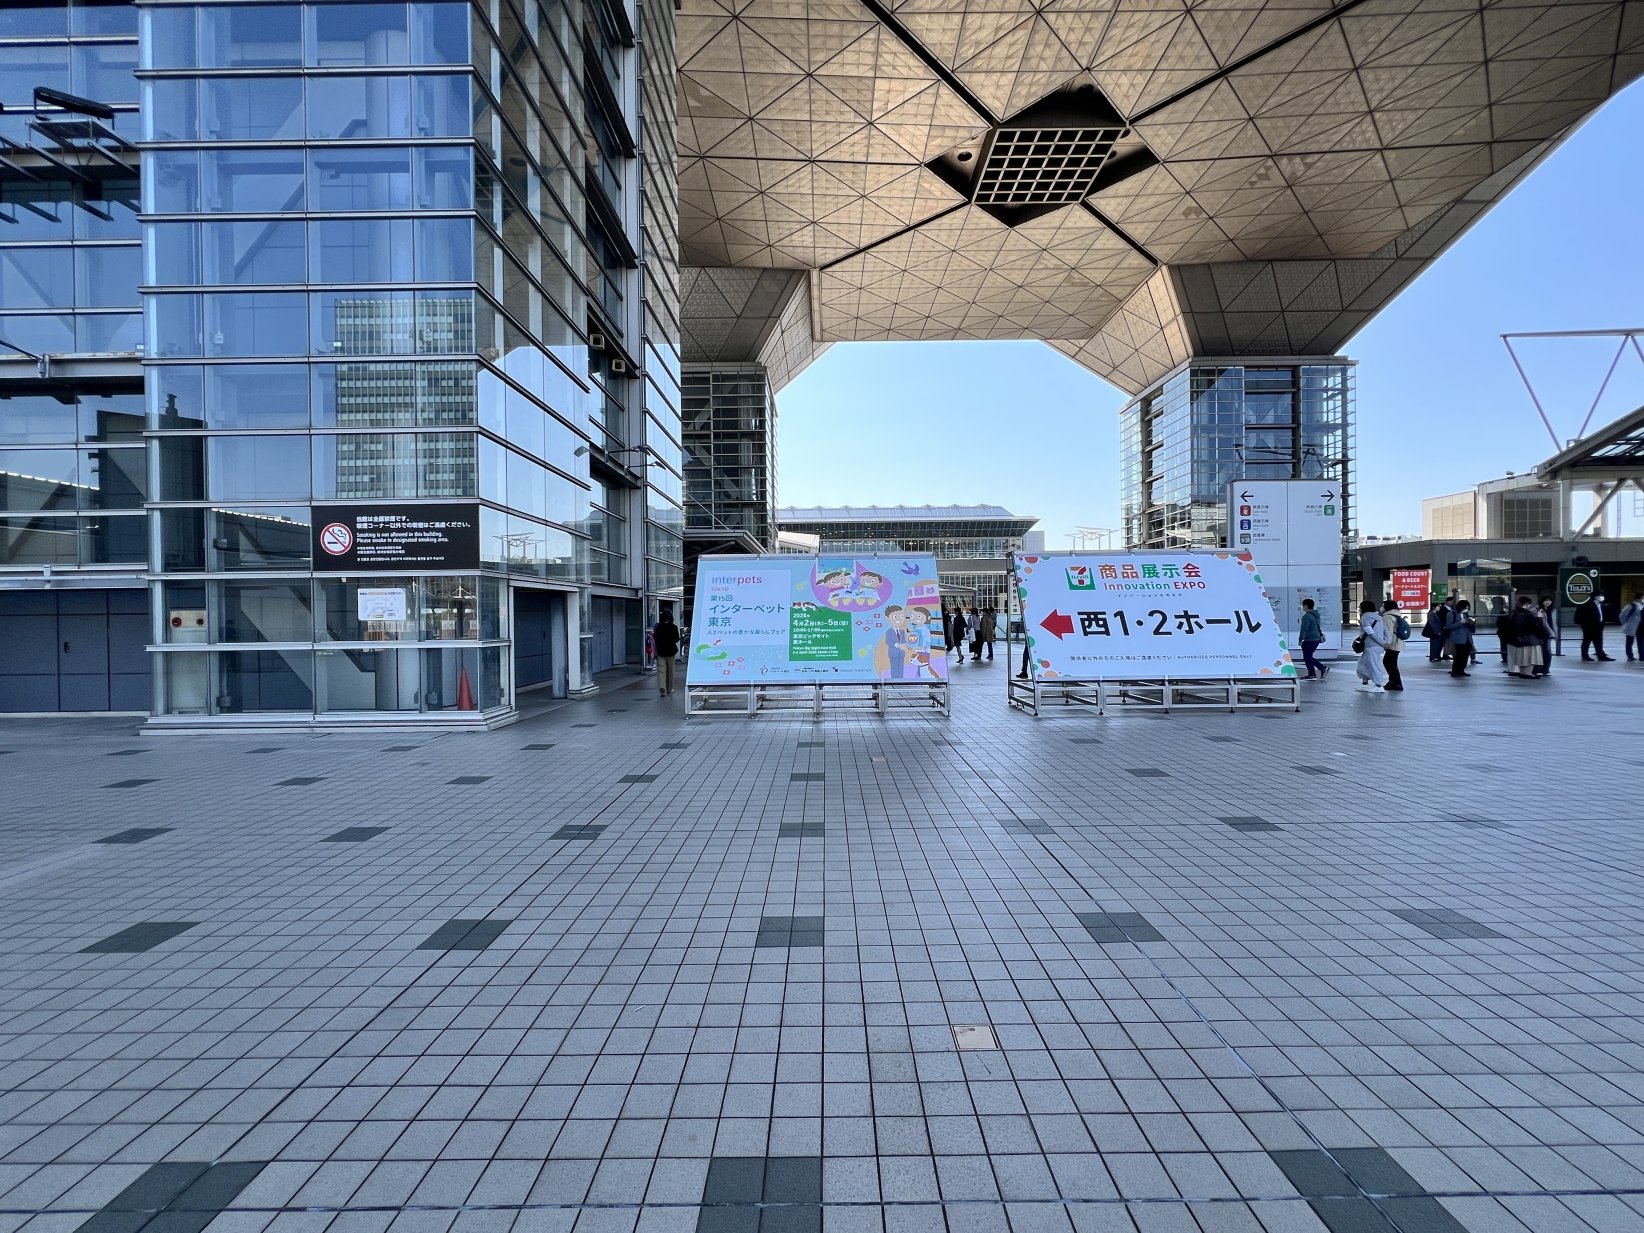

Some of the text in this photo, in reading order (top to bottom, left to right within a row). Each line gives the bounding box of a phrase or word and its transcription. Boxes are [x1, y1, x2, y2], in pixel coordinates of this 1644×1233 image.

[1098, 562, 1202, 580] 商品展示会
[712, 576, 762, 586] interpets
[1104, 581, 1206, 590] Innovation EXPO
[708, 617, 732, 627] 東京
